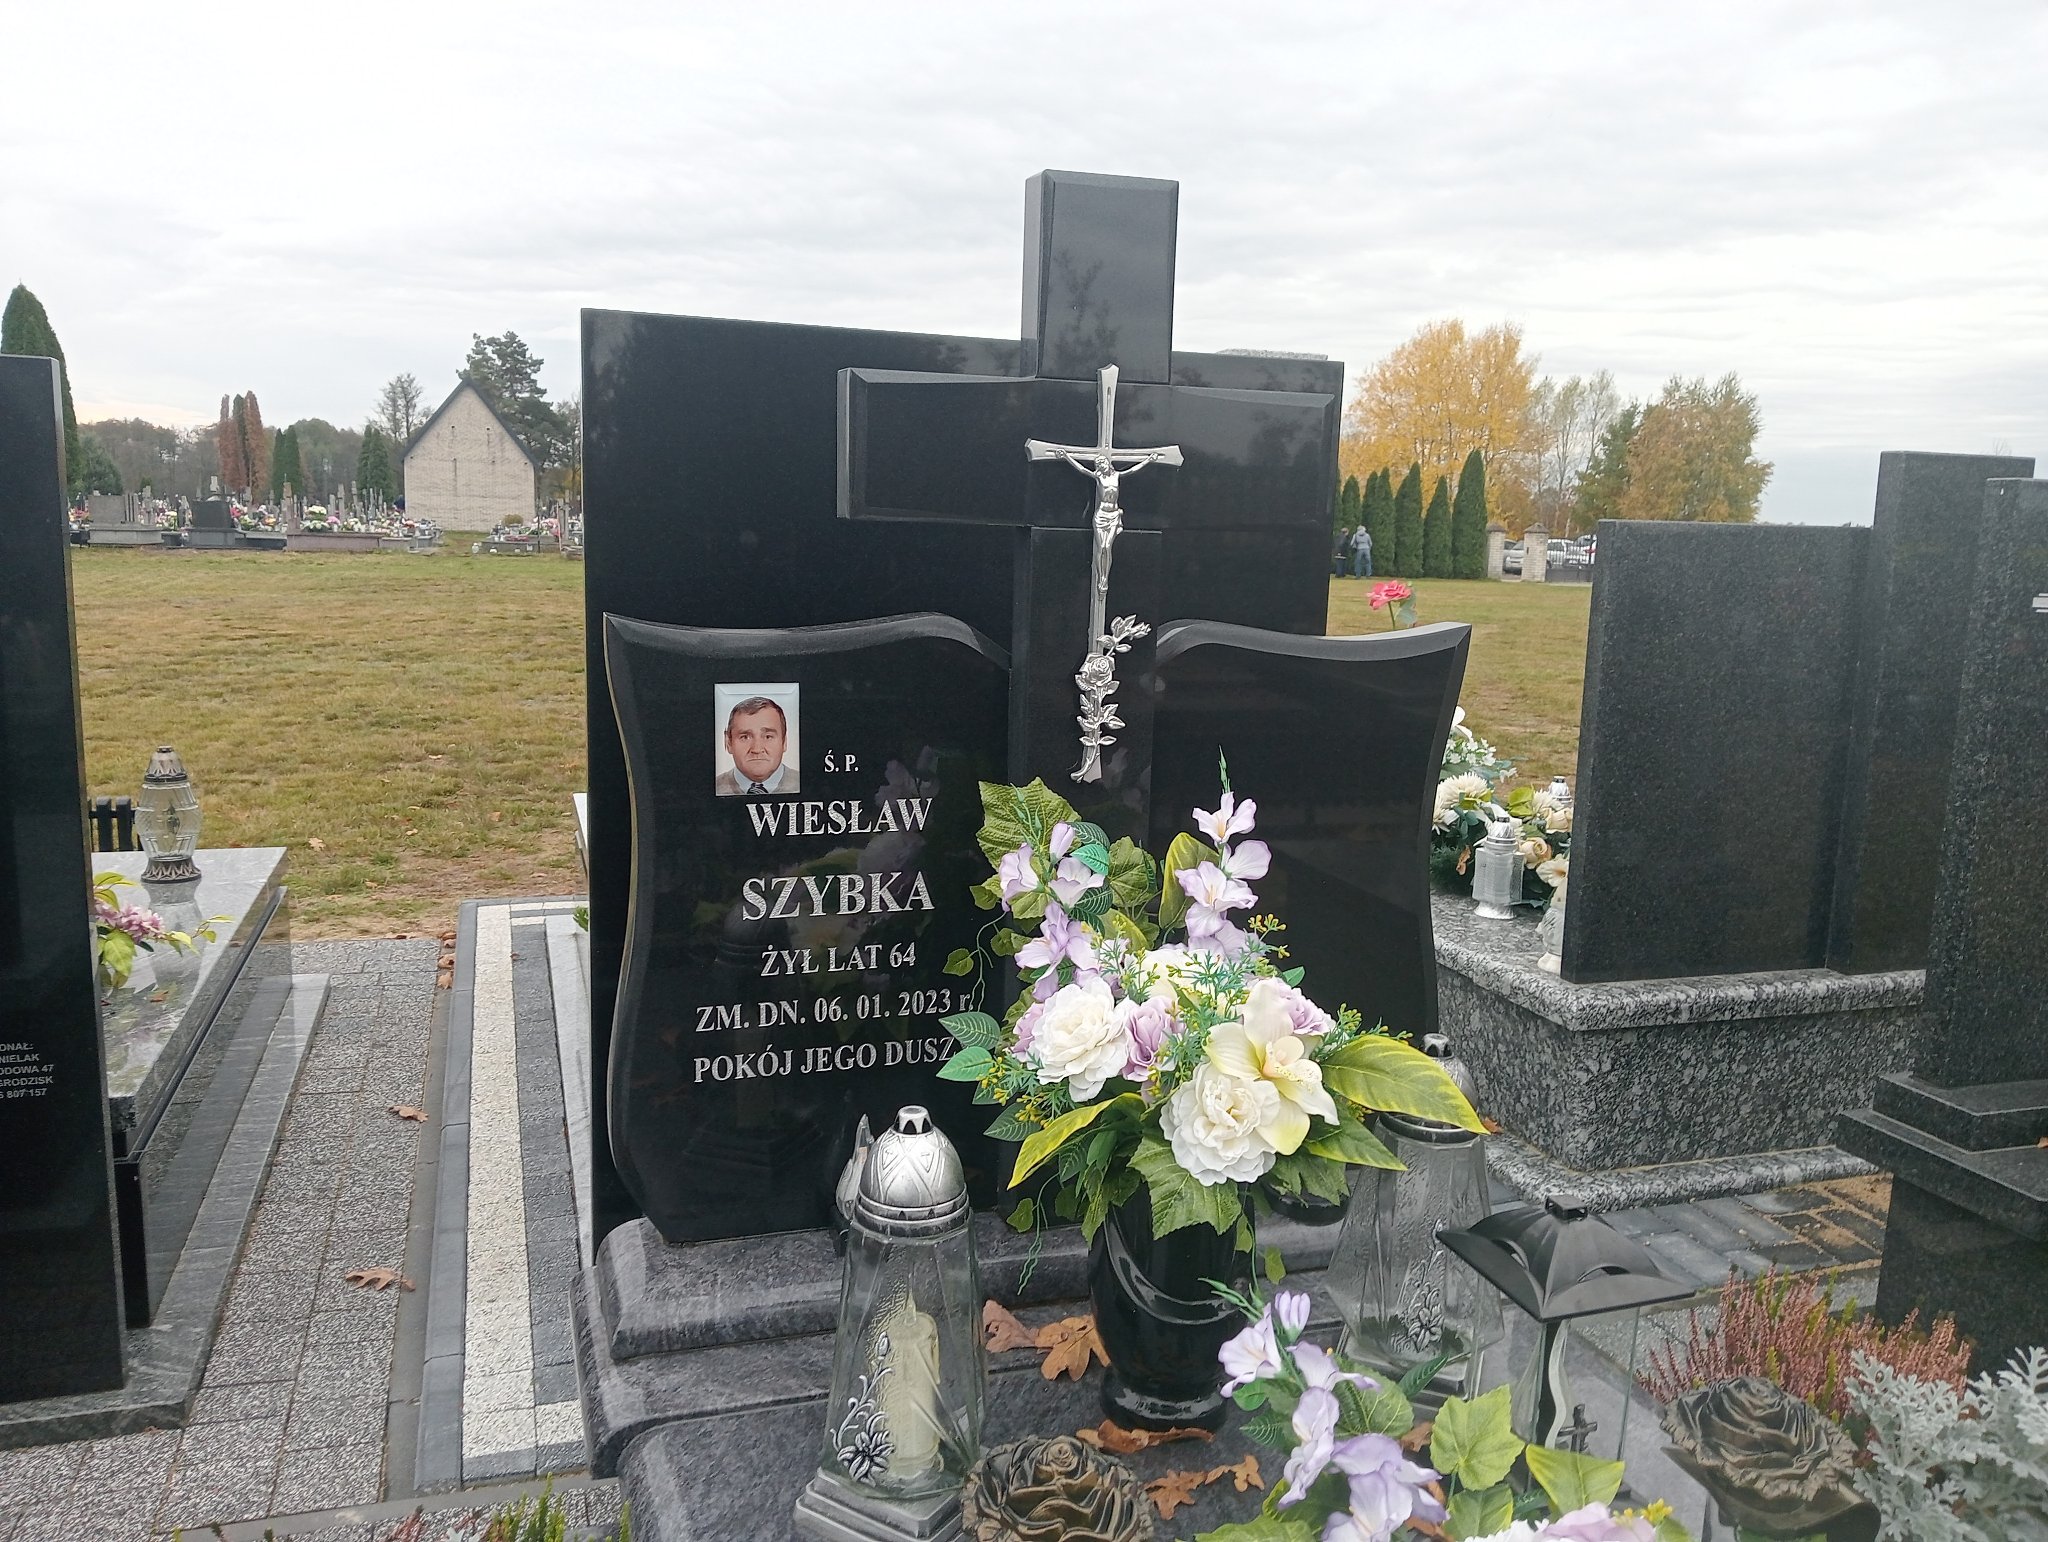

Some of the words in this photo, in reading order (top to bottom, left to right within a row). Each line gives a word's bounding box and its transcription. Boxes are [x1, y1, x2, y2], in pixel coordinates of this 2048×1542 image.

[824, 750, 839, 772] Ś.
[845, 754, 859, 772] P.
[746, 798, 933, 837] WIESŁAW
[742, 871, 935, 921] SZYBKA
[760, 945, 819, 977] ŻYŁ
[828, 944, 882, 972] LAT
[889, 942, 917, 968] 64
[695, 1002, 750, 1032] ZM.
[758, 999, 806, 1028] DN.
[814, 996, 848, 1024] 06.
[856, 993, 890, 1019] 01.
[898, 988, 951, 1016] 2023
[41, 1064, 54, 1072] 47
[694, 1046, 793, 1083] POKÓJ
[801, 1043, 876, 1073] JEGO
[884, 1036, 960, 1066] DUSZ
[29, 1088, 47, 1097] 157
